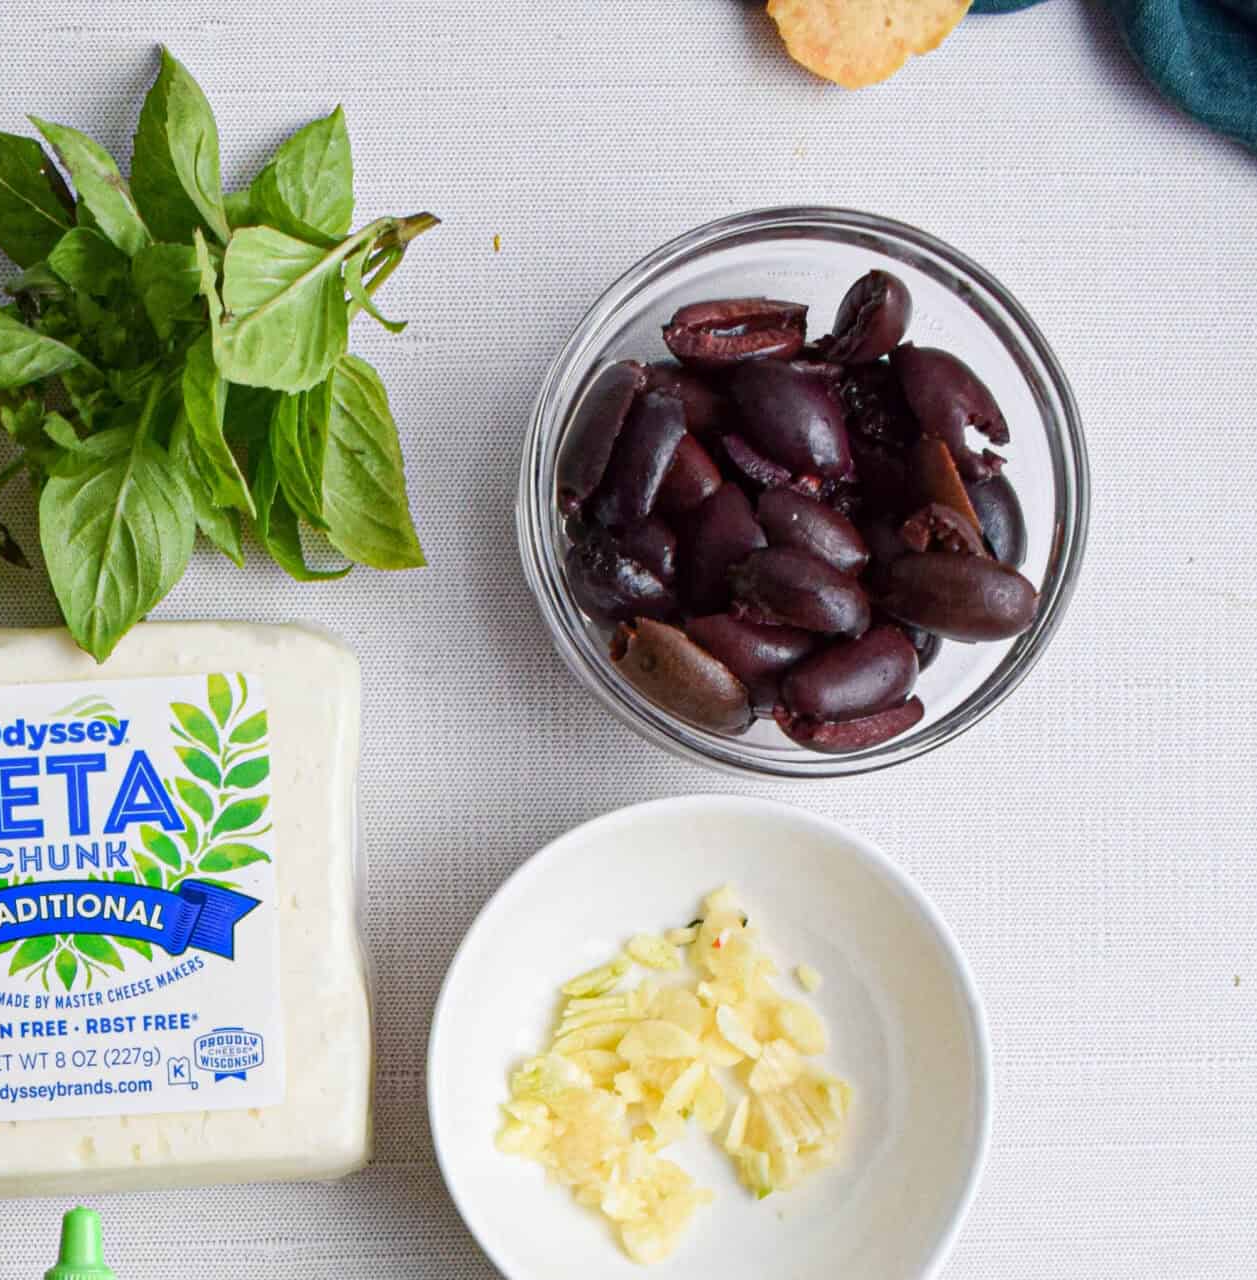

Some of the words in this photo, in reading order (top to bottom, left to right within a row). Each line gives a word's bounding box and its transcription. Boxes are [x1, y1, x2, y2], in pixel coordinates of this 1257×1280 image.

[35, 995, 50, 1009] BY
[55, 991, 104, 1009] MASTER
[107, 977, 155, 1003] CHEESE
[157, 955, 206, 987] MAKERS
[20, 1019, 68, 1038] FREE
[86, 1015, 137, 1035] RBST
[199, 1034, 259, 1050] PROUDLY
[18, 1052, 50, 1071] WT
[55, 1051, 67, 1069] 8
[71, 1050, 98, 1068] OZ
[103, 1046, 162, 1068] (227g)
[200, 1052, 259, 1069] WISCONSIN
[173, 1064, 185, 1078] K
